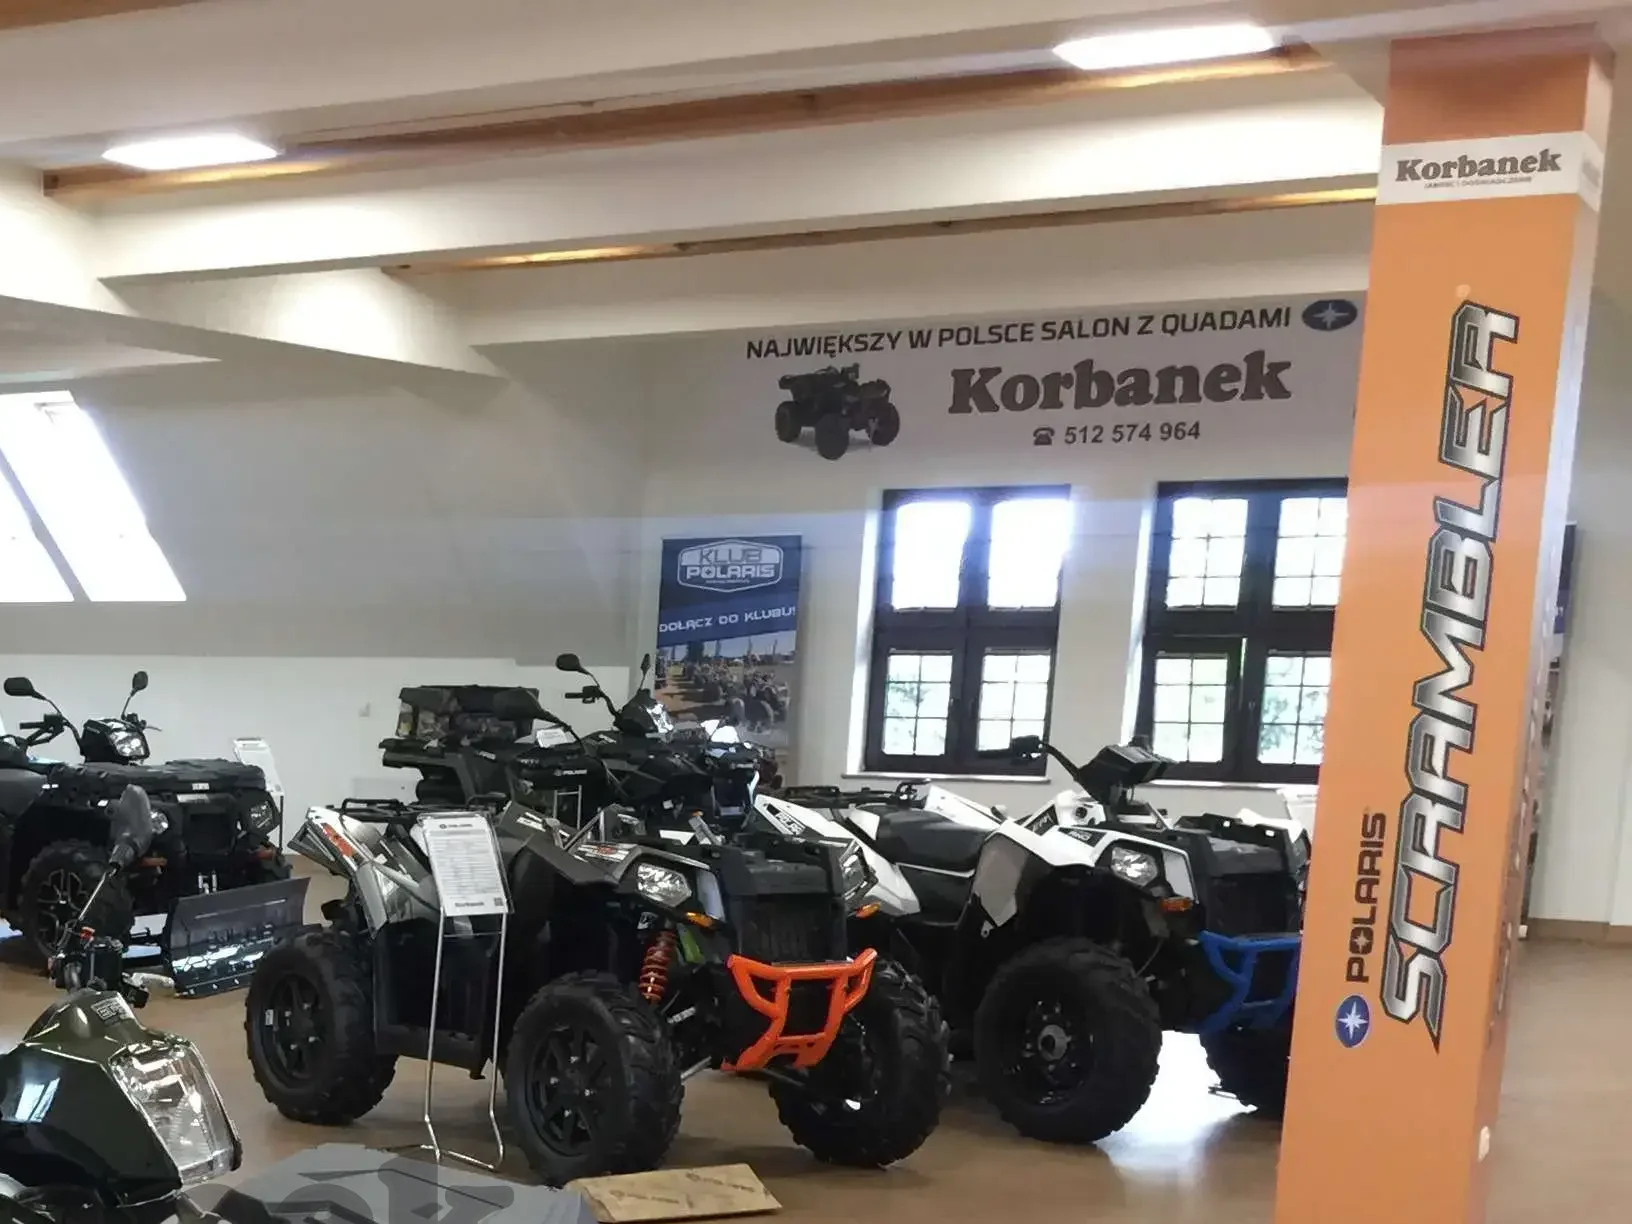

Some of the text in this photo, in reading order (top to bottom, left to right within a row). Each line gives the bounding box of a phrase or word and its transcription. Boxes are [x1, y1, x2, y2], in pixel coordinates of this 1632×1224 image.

[1395, 148, 1563, 182] Korbanek
[747, 307, 1291, 359] NAJWIĘKSZY W POLSCE SALON Z QUADAMI
[947, 349, 1292, 415] Korbanek
[1064, 420, 1201, 445] 512 574 964
[686, 565, 776, 580] POLARIS
[699, 548, 763, 564] KLUB
[718, 613, 739, 626] DO
[1380, 298, 1521, 1054] SCRAMBLER
[1346, 811, 1386, 984] POLARIS
